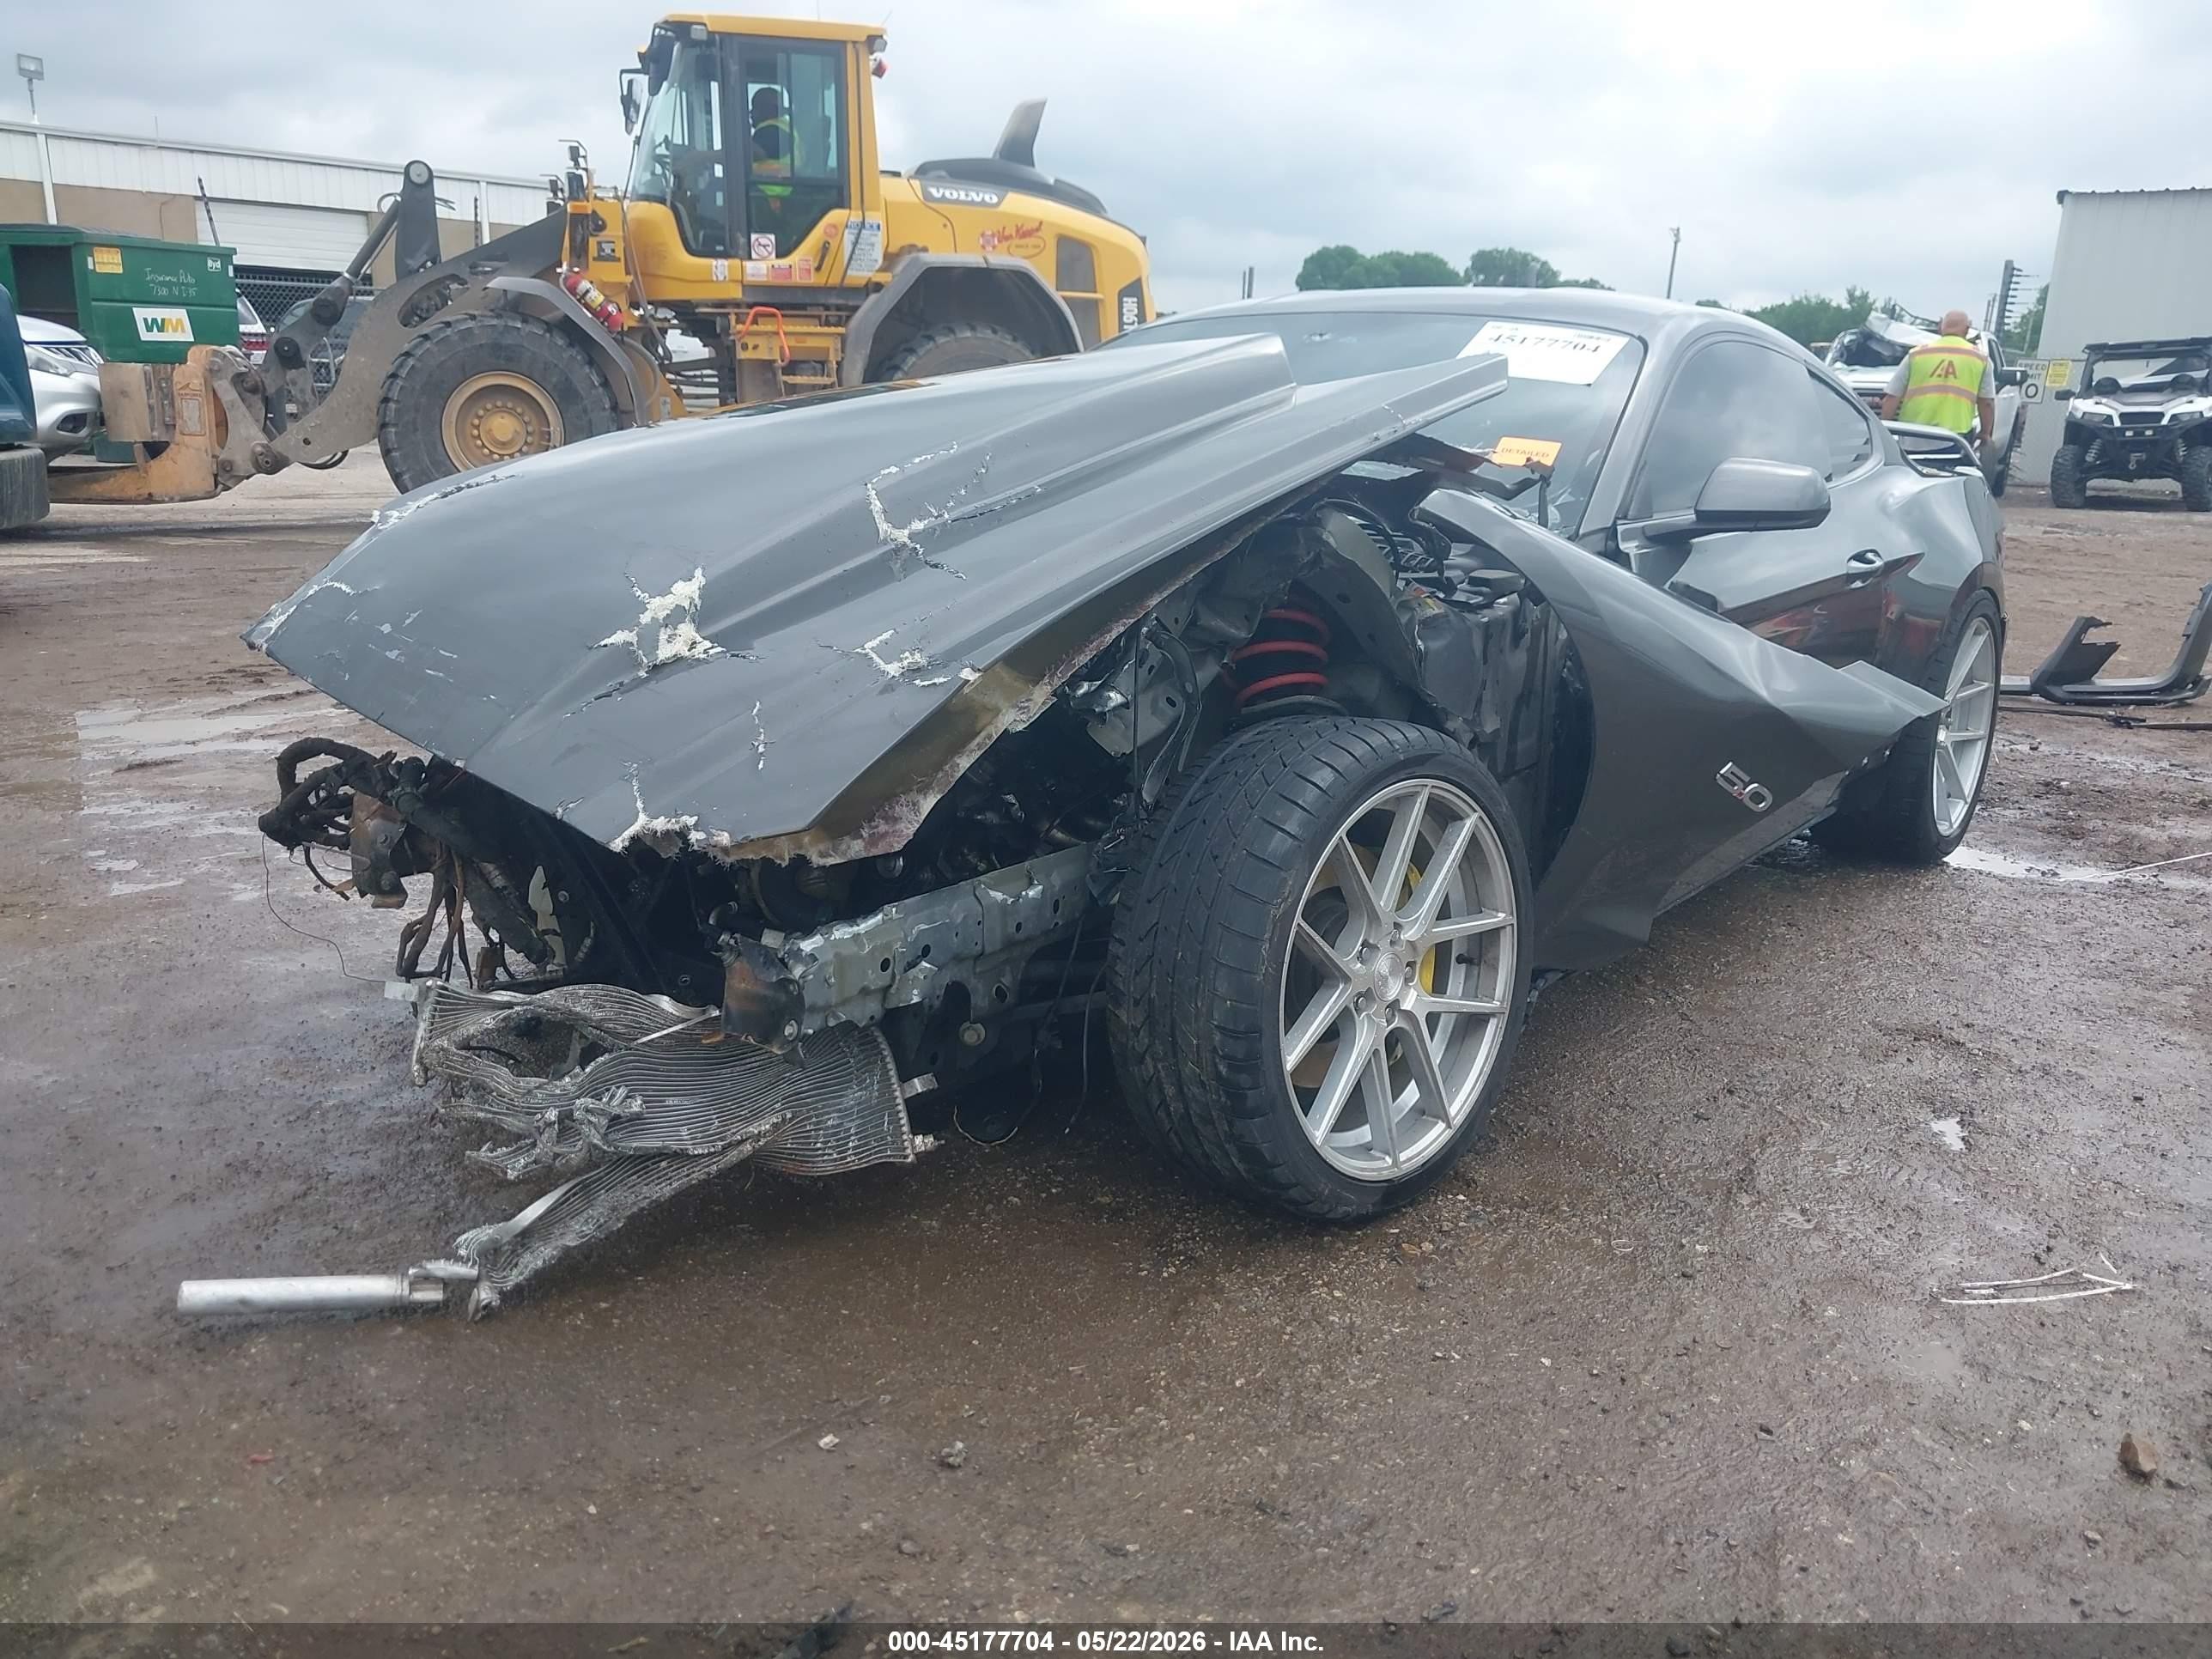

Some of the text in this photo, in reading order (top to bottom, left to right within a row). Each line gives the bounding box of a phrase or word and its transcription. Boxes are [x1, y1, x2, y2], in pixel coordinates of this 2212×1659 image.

[928, 186, 999, 204] VOLVO
[179, 269, 196, 284] Auto
[149, 283, 169, 296] 7300
[173, 286, 179, 295] N
[143, 316, 186, 333] WM
[1488, 333, 1601, 353] 45177704
[2018, 362, 2047, 371] SPEED
[1501, 447, 1550, 458] DETAILED
[1716, 761, 1773, 812] 5.0
